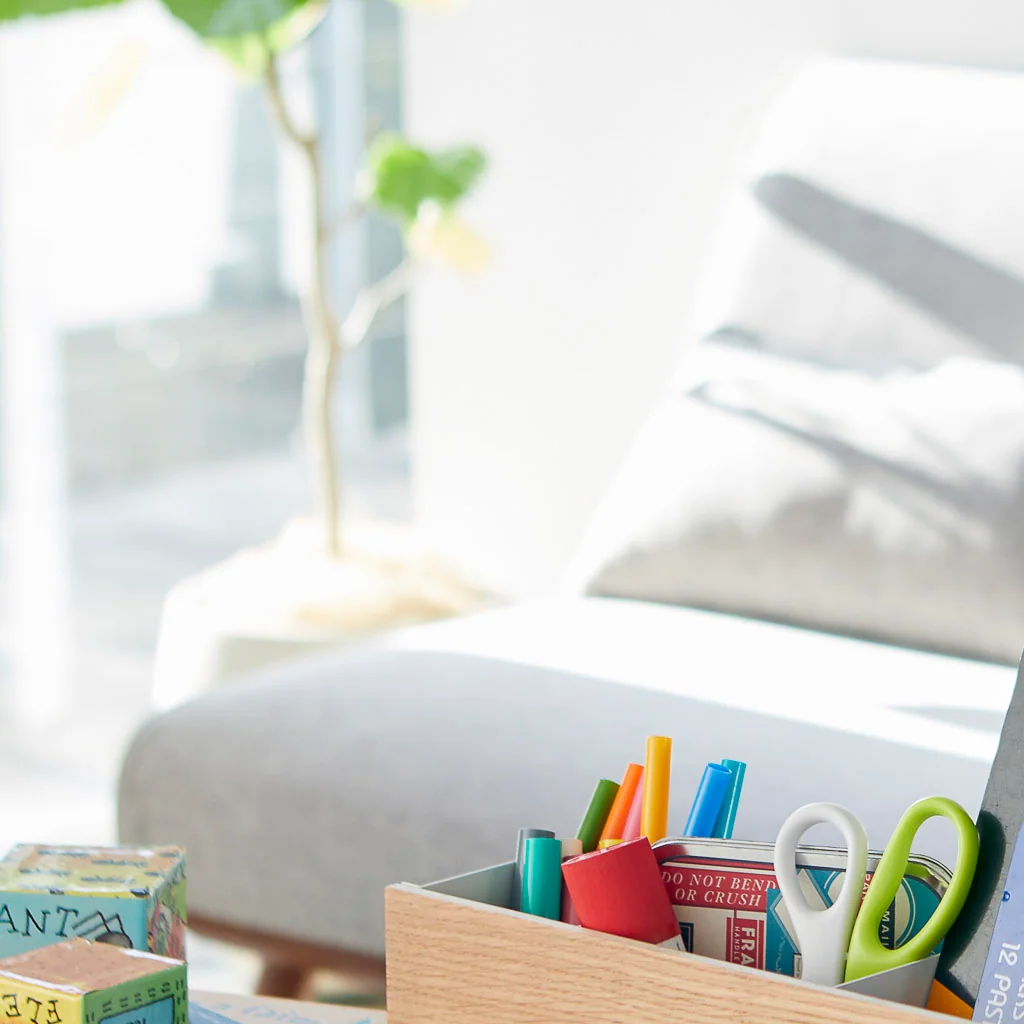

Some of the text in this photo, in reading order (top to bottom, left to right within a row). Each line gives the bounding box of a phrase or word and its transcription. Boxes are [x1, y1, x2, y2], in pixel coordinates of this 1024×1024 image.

[662, 871, 683, 885] DO
[689, 874, 726, 889] NOT
[675, 887, 762, 907] OR CRUSH
[0, 903, 80, 938] ANT
[733, 926, 741, 961] HANDLE
[741, 927, 756, 966] FRA
[998, 943, 1021, 966] 12
